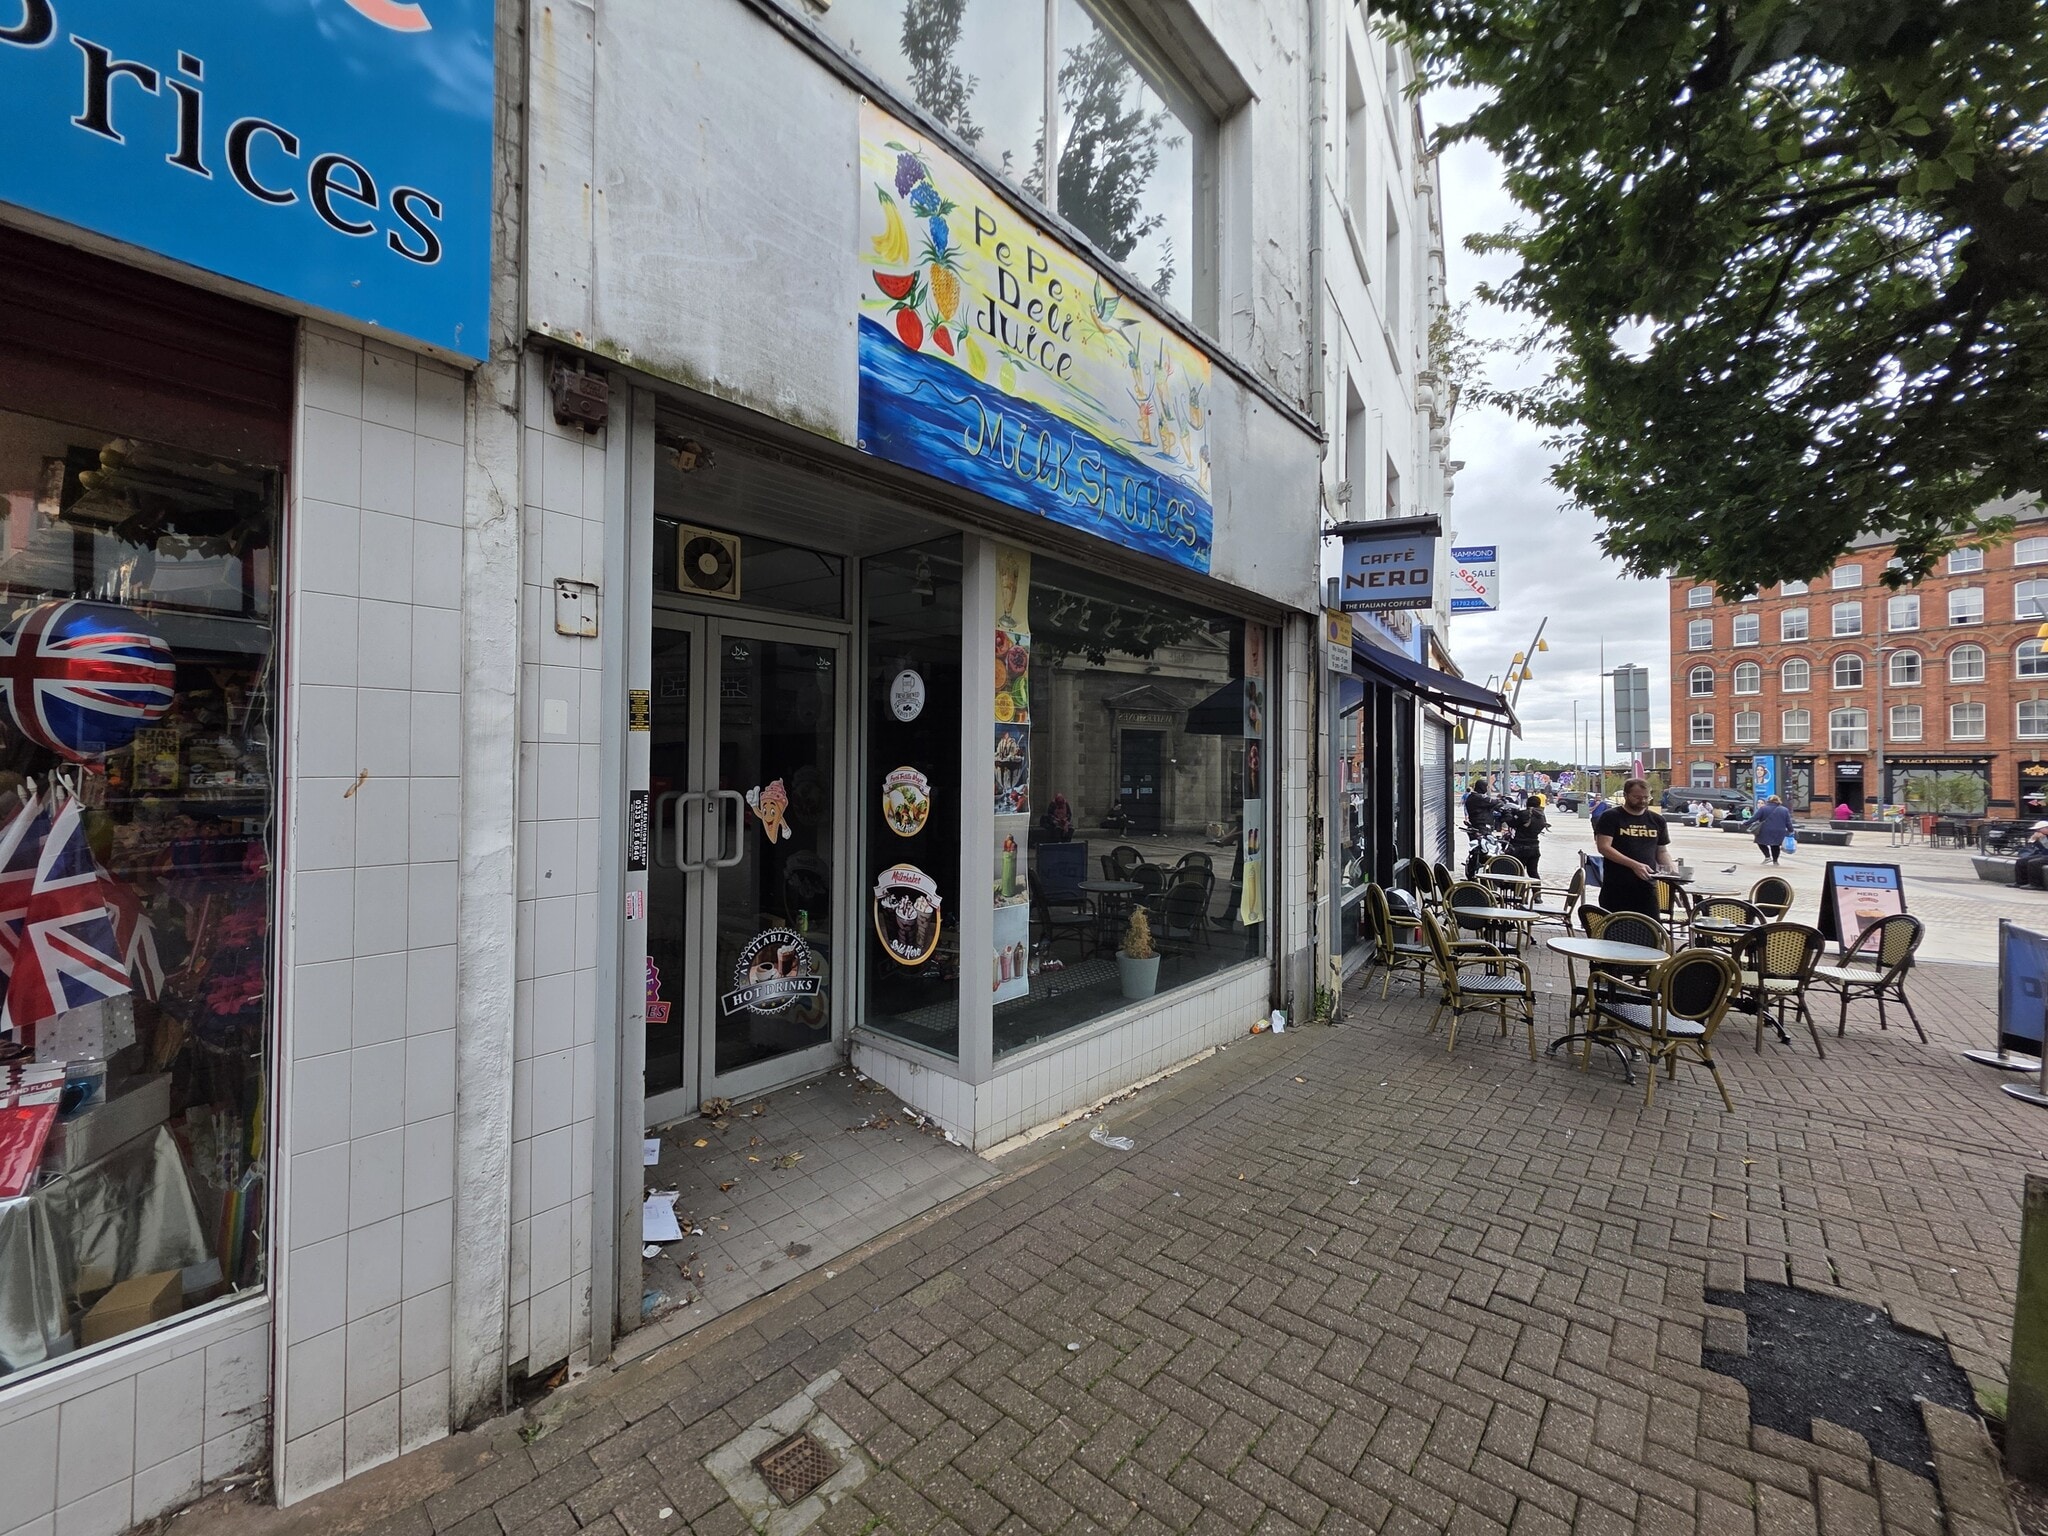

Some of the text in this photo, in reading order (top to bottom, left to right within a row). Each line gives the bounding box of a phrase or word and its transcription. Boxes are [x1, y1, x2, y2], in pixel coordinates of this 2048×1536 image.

[998, 265, 1074, 343] Deli
[977, 292, 1073, 381] Juice
[1345, 568, 1429, 590] NERO
[1458, 569, 1486, 595] SOLD
[1471, 570, 1496, 578] SALE
[1359, 601, 1387, 609] ITALIAN
[1388, 600, 1415, 608] COFFEE
[1619, 828, 1658, 838] NERO
[1843, 874, 1888, 884] NERO
[740, 934, 807, 976] AVAILABLE HERE
[732, 980, 813, 1006] HOT DRINKS
[30, 1082, 53, 1092] FLAG
